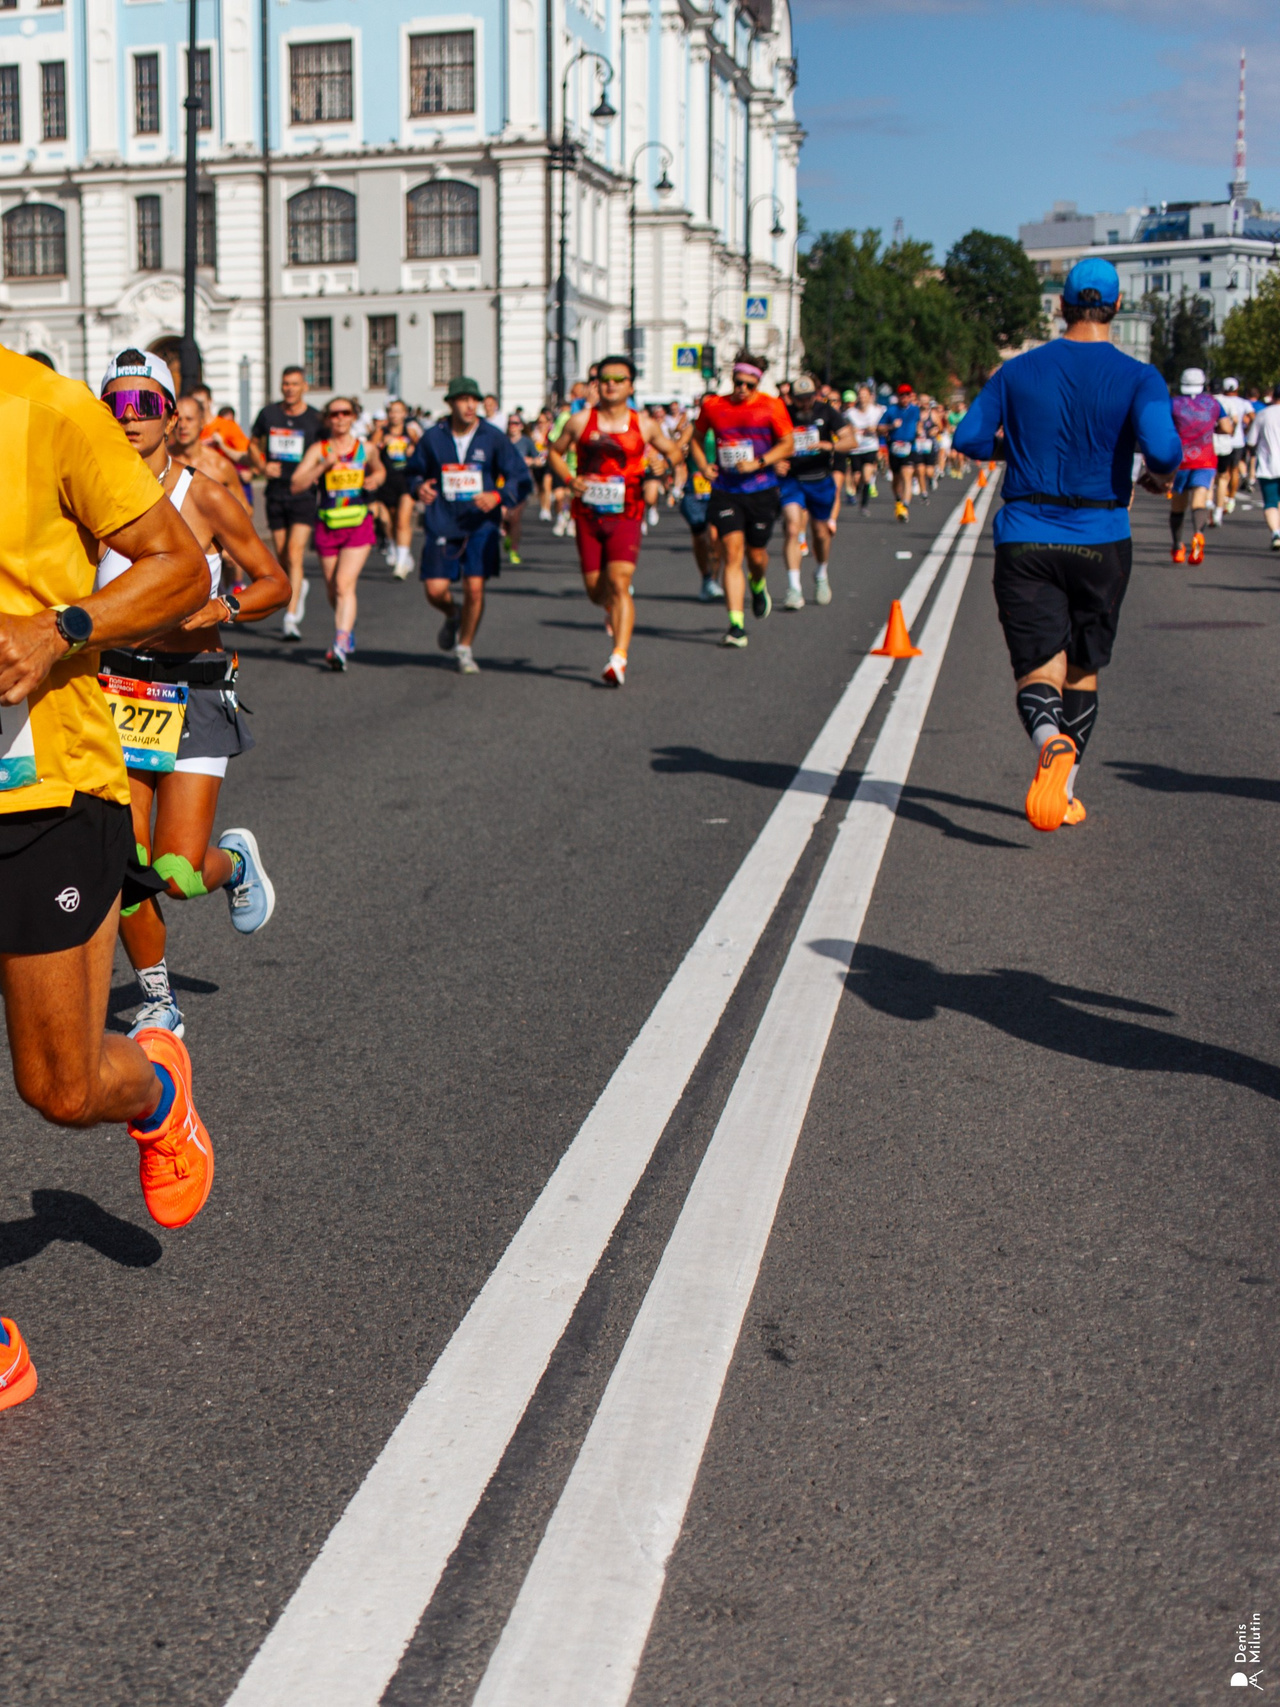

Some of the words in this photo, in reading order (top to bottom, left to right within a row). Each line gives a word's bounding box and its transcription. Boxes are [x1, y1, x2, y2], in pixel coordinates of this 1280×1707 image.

[146, 687, 160, 697] 21,1
[108, 702, 172, 735] 1277
[119, 732, 160, 745] КСАНДРА
